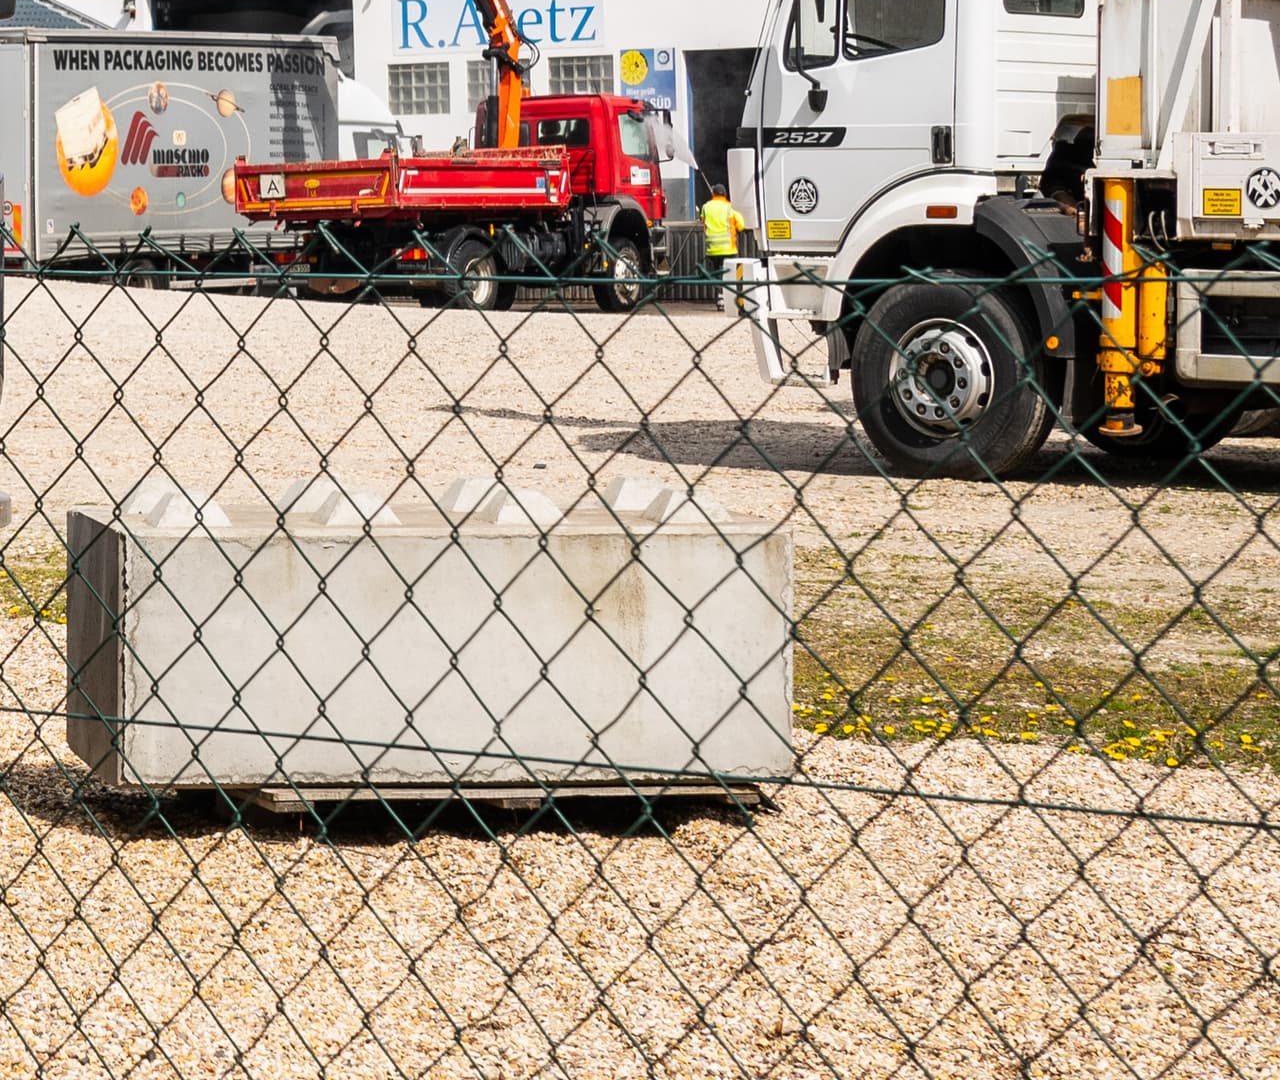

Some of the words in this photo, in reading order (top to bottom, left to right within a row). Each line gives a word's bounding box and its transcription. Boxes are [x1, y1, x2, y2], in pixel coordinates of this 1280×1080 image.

[53, 49, 100, 71] WHEN
[104, 49, 194, 71] PACKAGING
[197, 51, 264, 73] BECOMES
[266, 52, 326, 76] PASSION
[649, 94, 672, 109] SÜD
[773, 131, 834, 144] 2527
[267, 179, 280, 194] A
